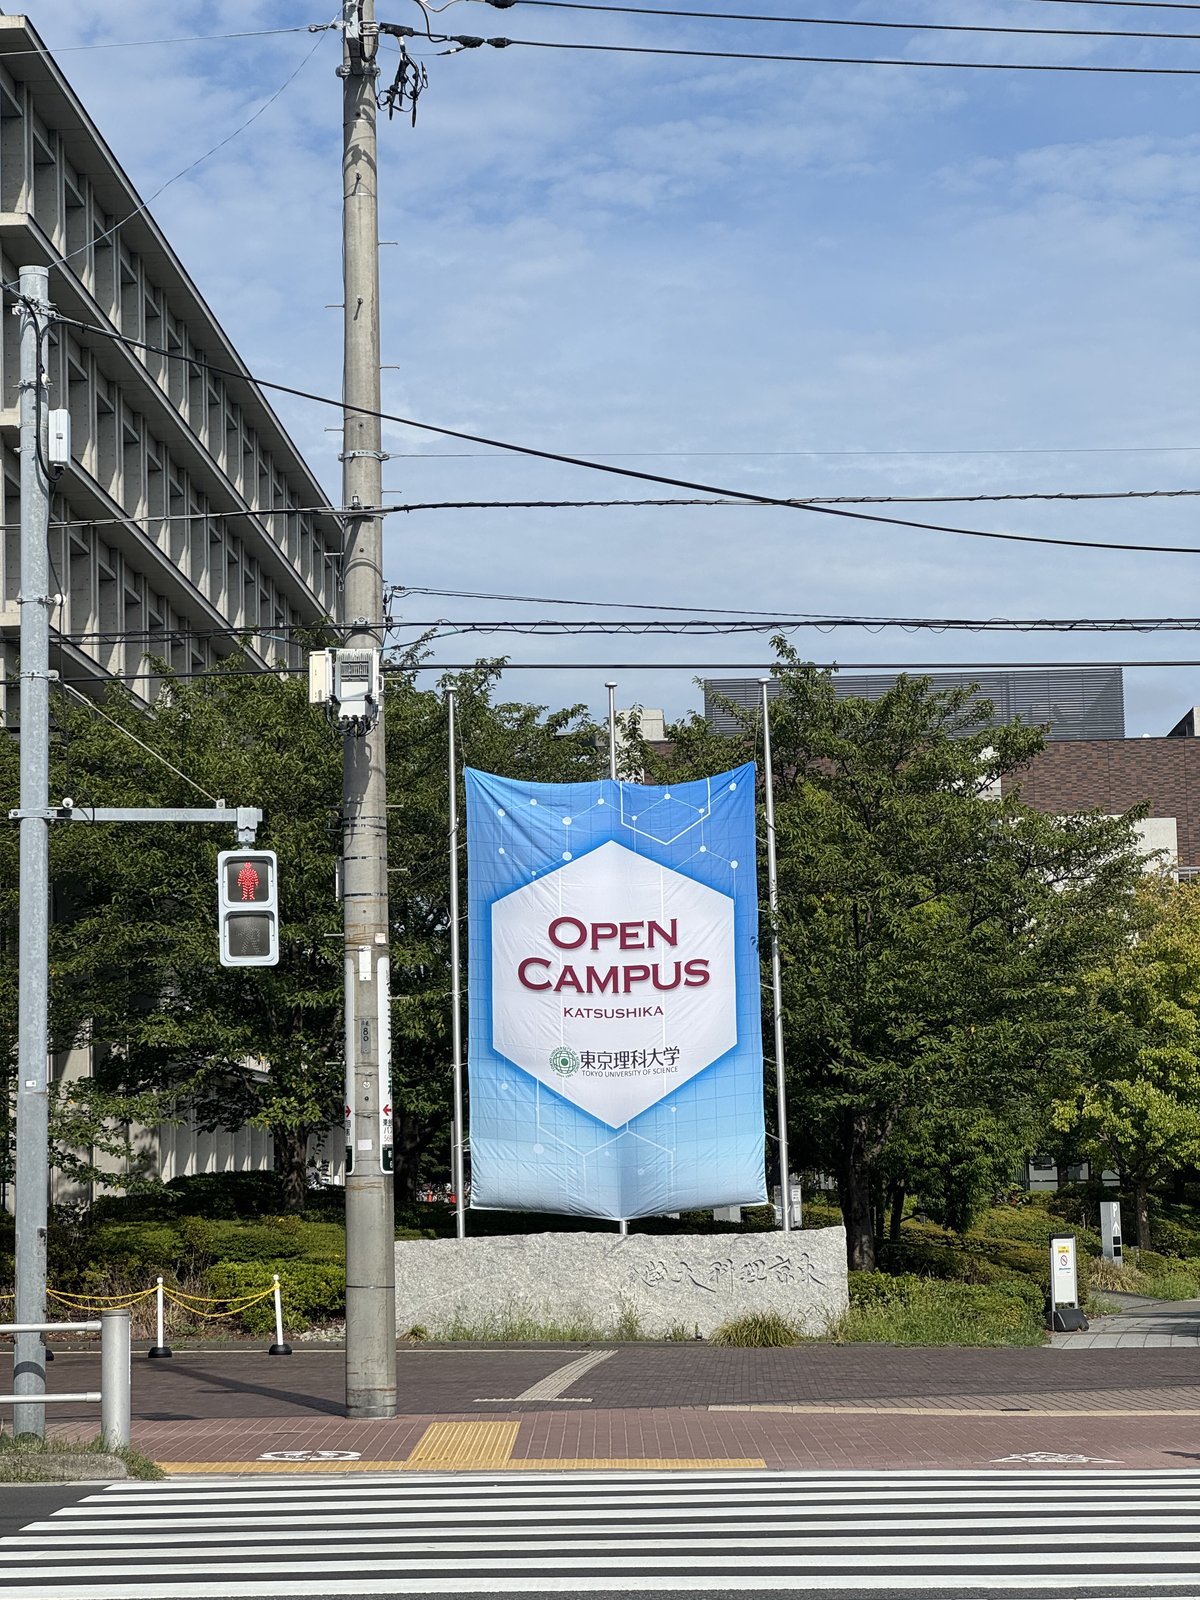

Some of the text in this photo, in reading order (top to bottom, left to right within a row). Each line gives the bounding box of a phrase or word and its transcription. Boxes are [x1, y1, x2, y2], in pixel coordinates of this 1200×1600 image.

[548, 916, 678, 950] OPEN
[518, 957, 710, 994] CAMPUS
[563, 1006, 664, 1019] KATSUSHIKA
[580, 1046, 680, 1070] 東京理科大学
[604, 1069, 641, 1078] UNIVERSITY
[652, 1066, 678, 1074] SCIENCE
[1112, 1203, 1118, 1218] P
